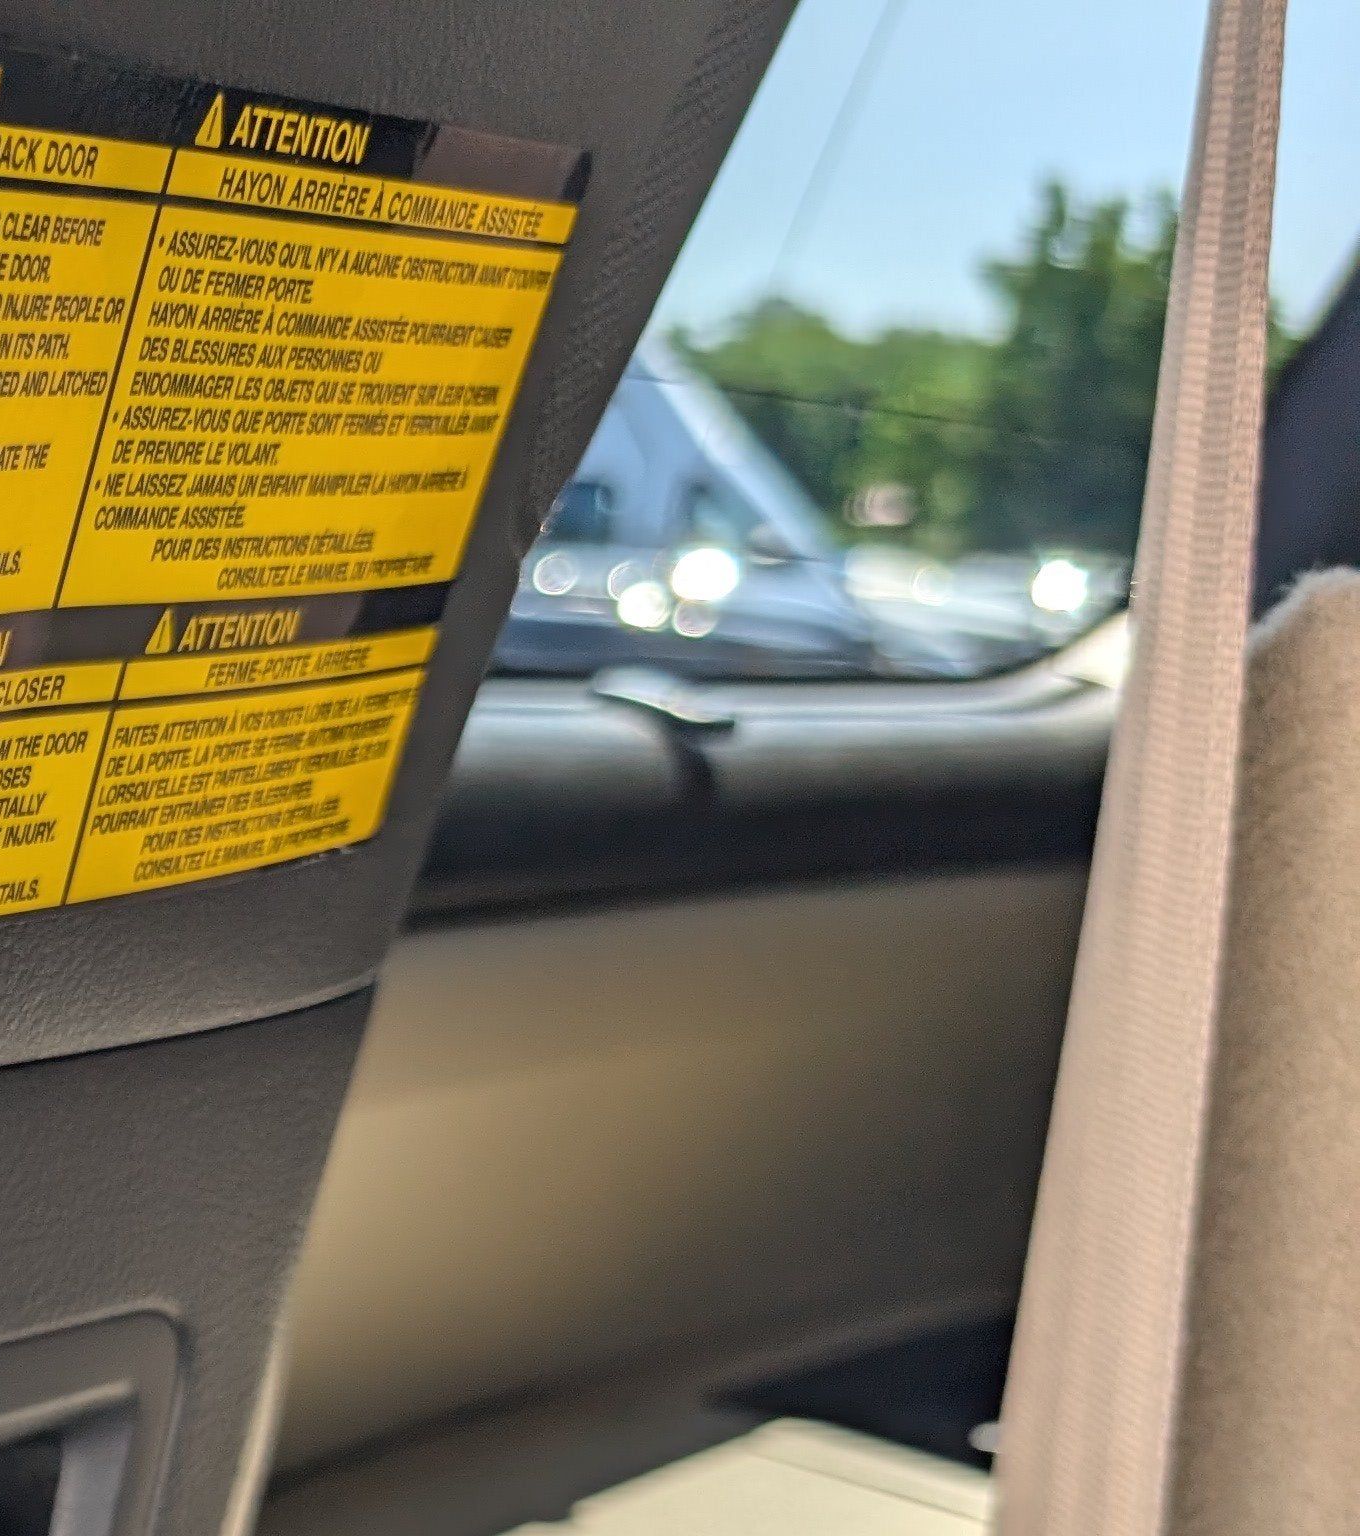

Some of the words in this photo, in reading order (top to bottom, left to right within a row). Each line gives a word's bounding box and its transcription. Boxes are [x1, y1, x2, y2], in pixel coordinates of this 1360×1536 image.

[229, 105, 371, 165] ATTENTION
[43, 140, 98, 178] DOOR
[218, 167, 285, 203] HAYON
[288, 175, 370, 217] ARRIÈRE
[370, 181, 387, 217] À
[387, 192, 475, 231] COMMANDE
[479, 204, 544, 238] ASSISTÉE
[2, 212, 49, 242] CLEAR
[50, 216, 106, 246] BEFORE
[166, 230, 278, 266] ASSUREZ-VOUS
[278, 241, 312, 271] QU'IL
[315, 247, 339, 273] N'Y
[337, 250, 350, 273] A
[349, 251, 404, 279] AUCUNE
[401, 255, 478, 286] OBSTRUCTION
[158, 266, 181, 293] OU
[181, 268, 204, 295] DE
[203, 270, 266, 300] FERMER
[1, 295, 48, 321] INJURE
[49, 296, 100, 323] PEOPLE
[102, 298, 125, 324] OR
[147, 301, 199, 330] HAYON
[198, 302, 264, 334] ARRIÈRE
[276, 310, 353, 341] COMMANDE
[351, 315, 409, 344] ASSISTÉE
[11, 333, 36, 359] ITS
[138, 336, 170, 363] DES
[170, 338, 257, 367] BLESSURES
[255, 343, 287, 368] AUX
[285, 345, 364, 374] PERSONNES
[363, 350, 383, 374] OU
[20, 371, 46, 397] AND
[48, 371, 108, 397] LATCHED
[130, 370, 234, 400] ENDOMMAGER
[233, 376, 263, 401] LES
[263, 377, 314, 404] OBJETS
[314, 380, 338, 404] QUI
[337, 382, 356, 405] SE
[120, 405, 231, 433] ASSUREZ-VOUS
[231, 409, 261, 434] QUE
[261, 410, 307, 435] PORTE
[306, 412, 344, 436] SONT
[24, 443, 51, 470] THE
[111, 439, 134, 464] DE
[133, 440, 205, 465] PRENDRE
[204, 441, 227, 466] LE
[102, 473, 125, 498] NE
[125, 473, 187, 498] LAISSEZ
[186, 474, 237, 497] JAMAIS
[237, 475, 260, 497] UN
[257, 474, 308, 497] ENFANT
[94, 505, 180, 531] COMMANDE
[150, 538, 192, 562] POUR
[192, 537, 221, 561] DES
[221, 533, 311, 560] INSTRUCTIONS
[217, 564, 289, 591] CONSULTEZ
[289, 564, 307, 586] LE
[177, 609, 302, 653] ATTENTION
[205, 653, 310, 688] FERME-PORTE
[15, 736, 43, 760] THE
[43, 731, 89, 756] DOOR
[112, 723, 160, 749] FAITES
[159, 717, 227, 744] ATTENTION
[105, 756, 125, 778] DE
[127, 753, 144, 775] LA
[194, 745, 210, 768] LA
[97, 775, 188, 807] LORSQU'ELLE
[188, 772, 213, 793] EST
[1, 819, 58, 848] INJURY.
[90, 805, 159, 836] POURRAIT
[140, 831, 177, 855] POUR
